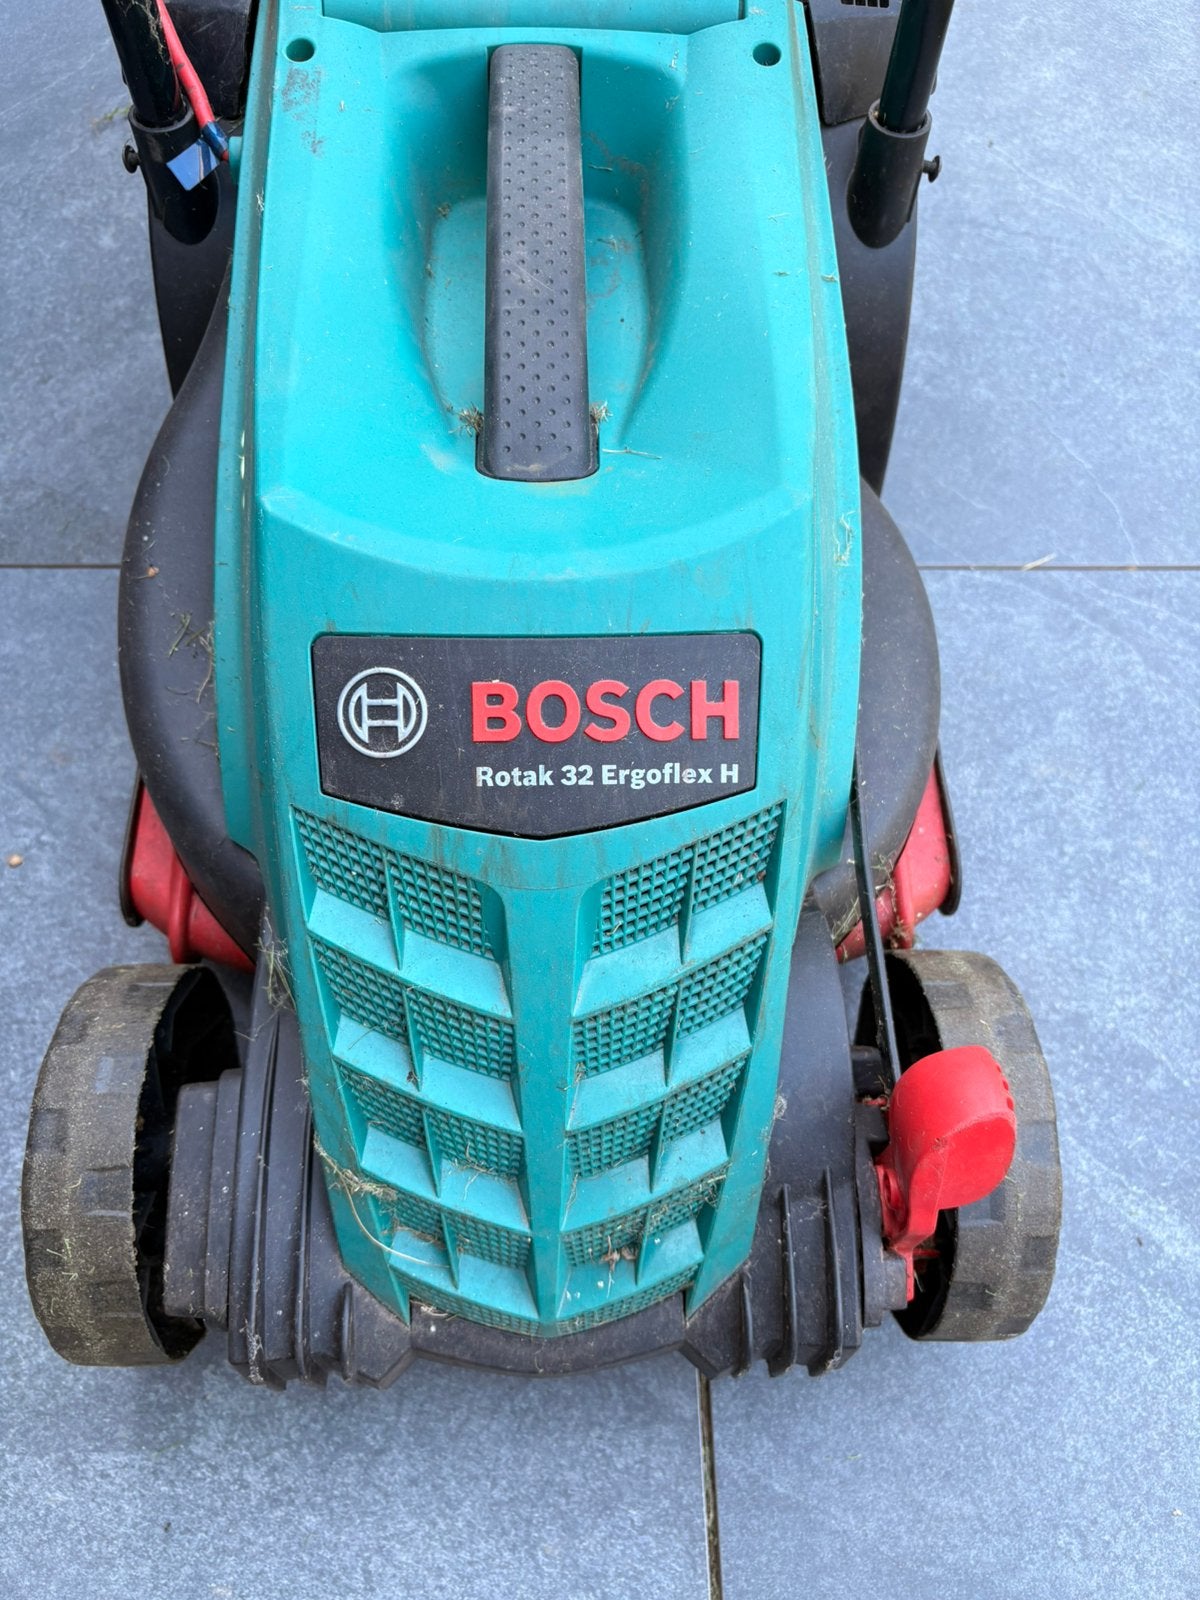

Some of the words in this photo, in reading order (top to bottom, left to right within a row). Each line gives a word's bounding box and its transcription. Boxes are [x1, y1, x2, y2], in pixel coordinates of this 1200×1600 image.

[471, 679, 741, 743] BOSCH
[475, 764, 555, 787] Rotak
[560, 764, 595, 786] 32
[601, 762, 713, 791] Ergoflex
[719, 763, 739, 784] H
